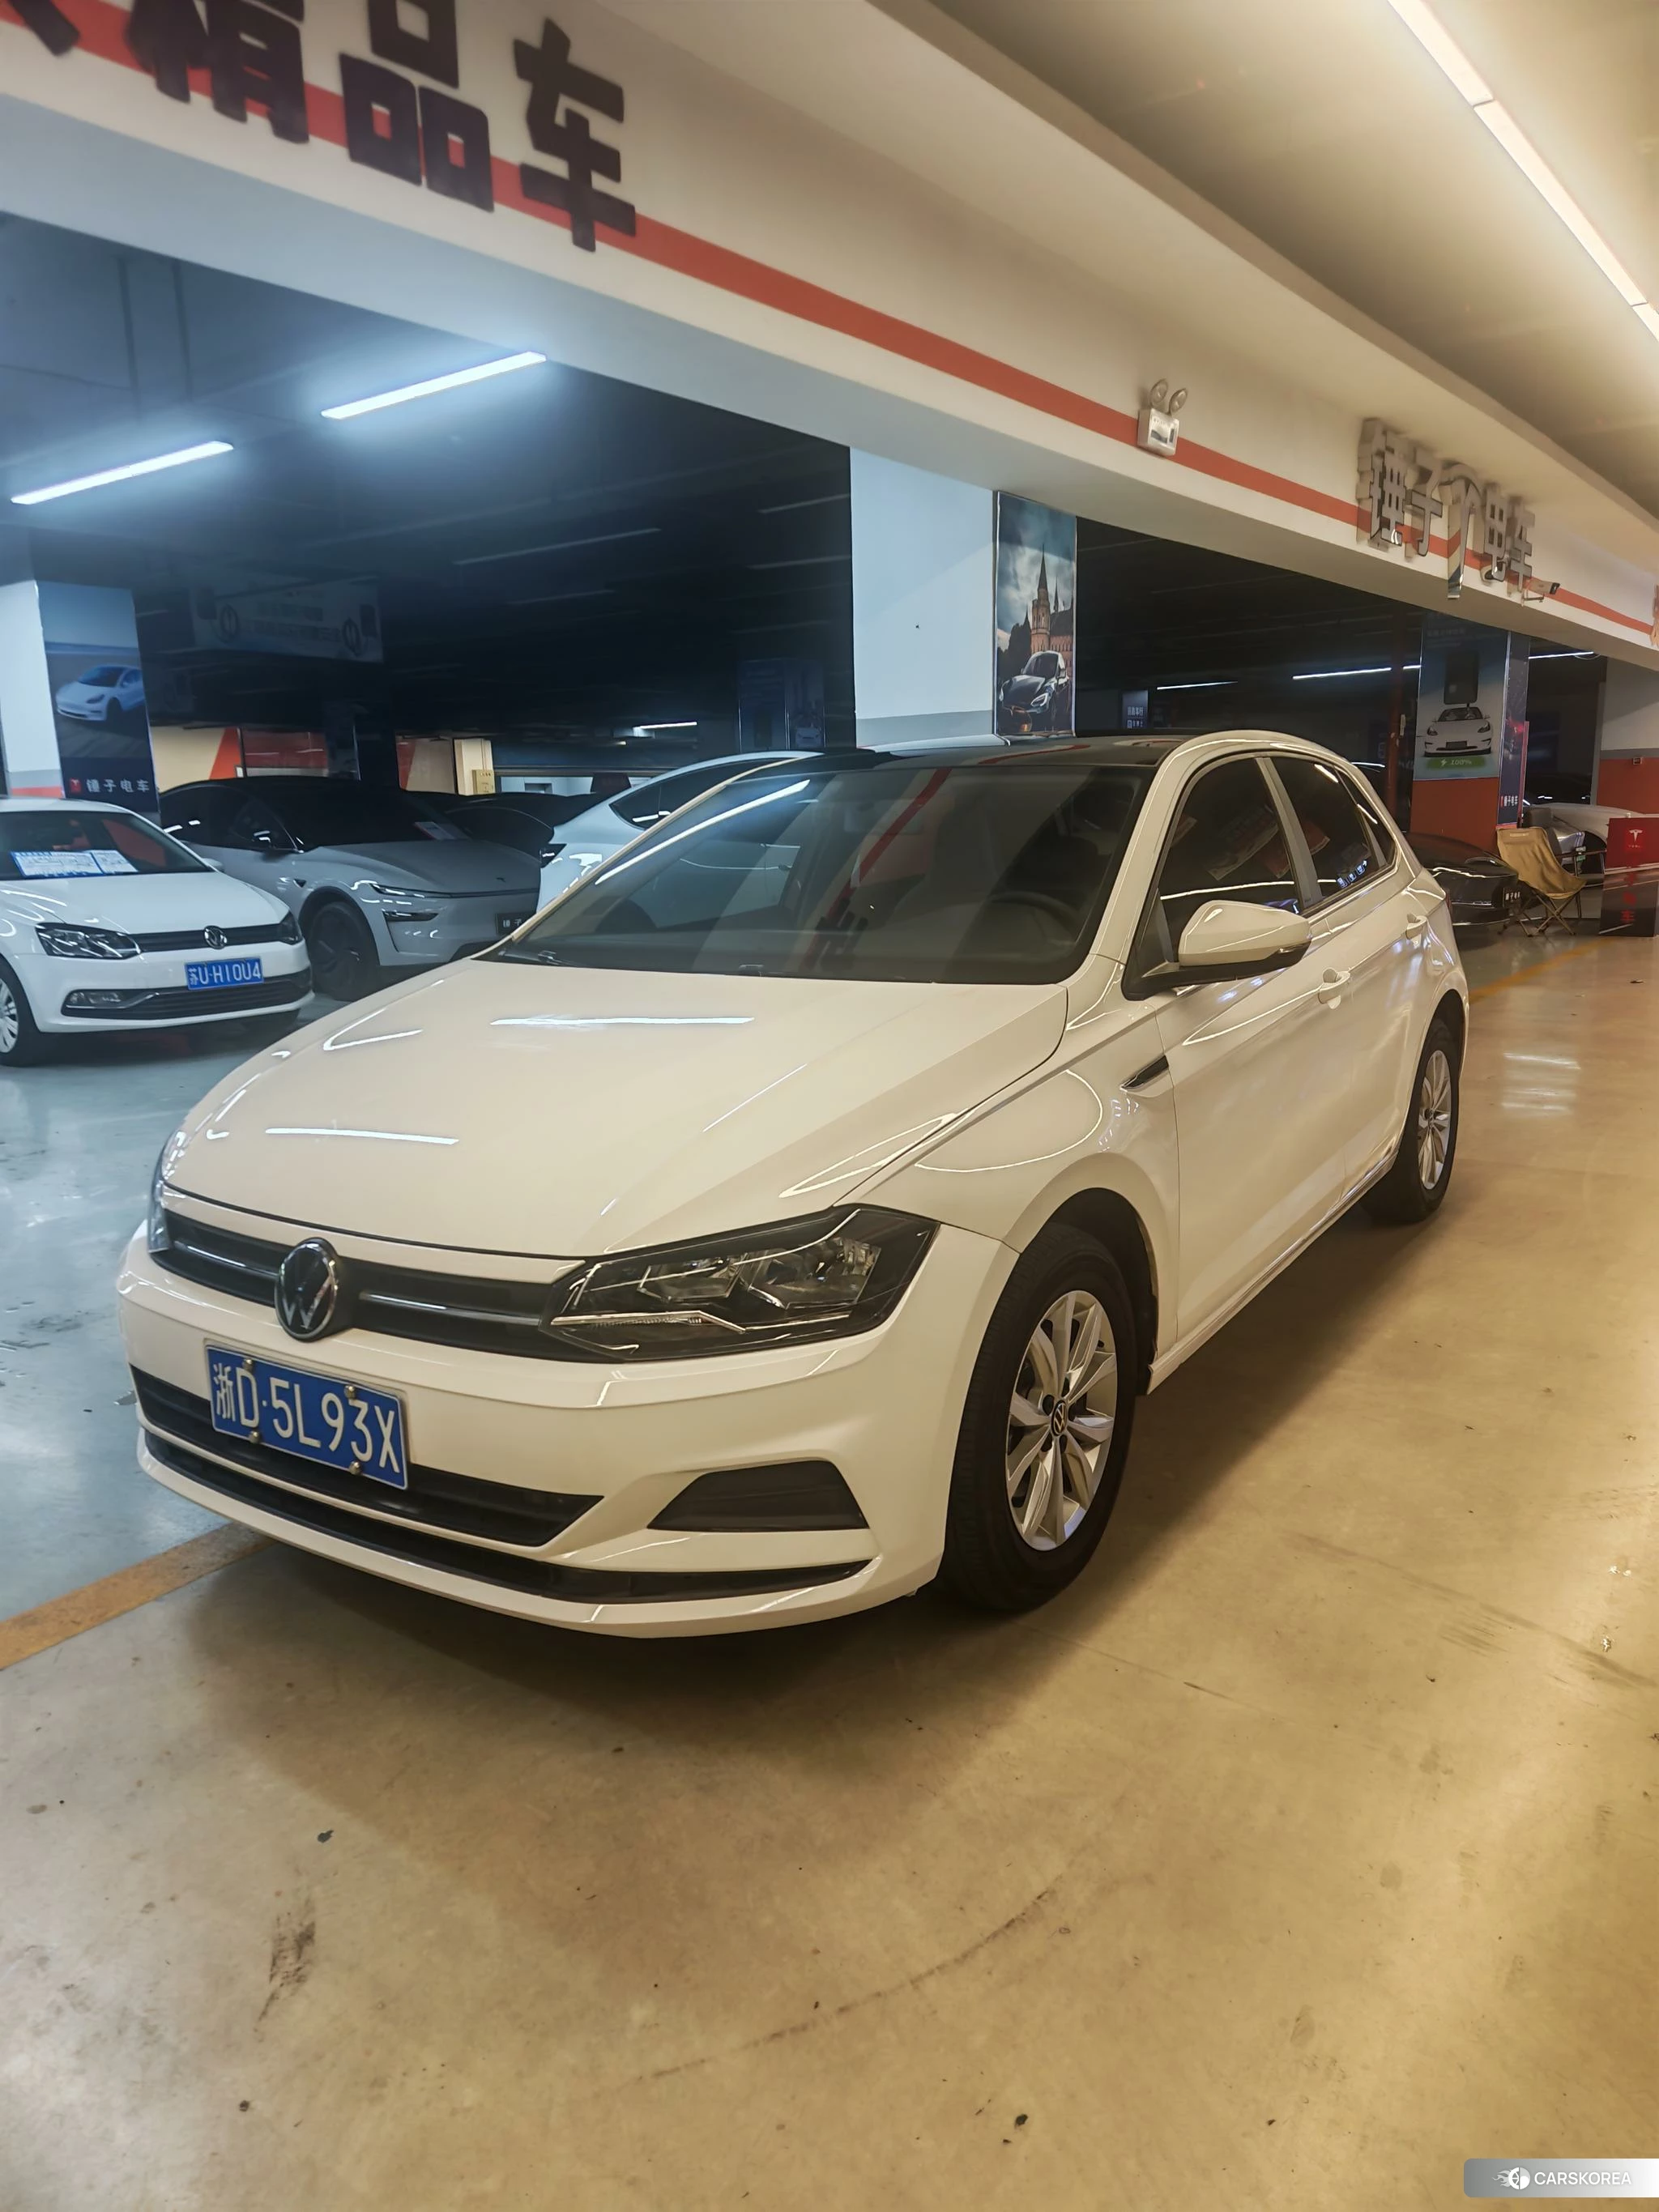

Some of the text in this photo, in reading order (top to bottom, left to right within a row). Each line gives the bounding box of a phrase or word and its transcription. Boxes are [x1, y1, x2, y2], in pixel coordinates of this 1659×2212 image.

[16, 0, 638, 253] 精品车
[1450, 757, 1472, 766] 100%
